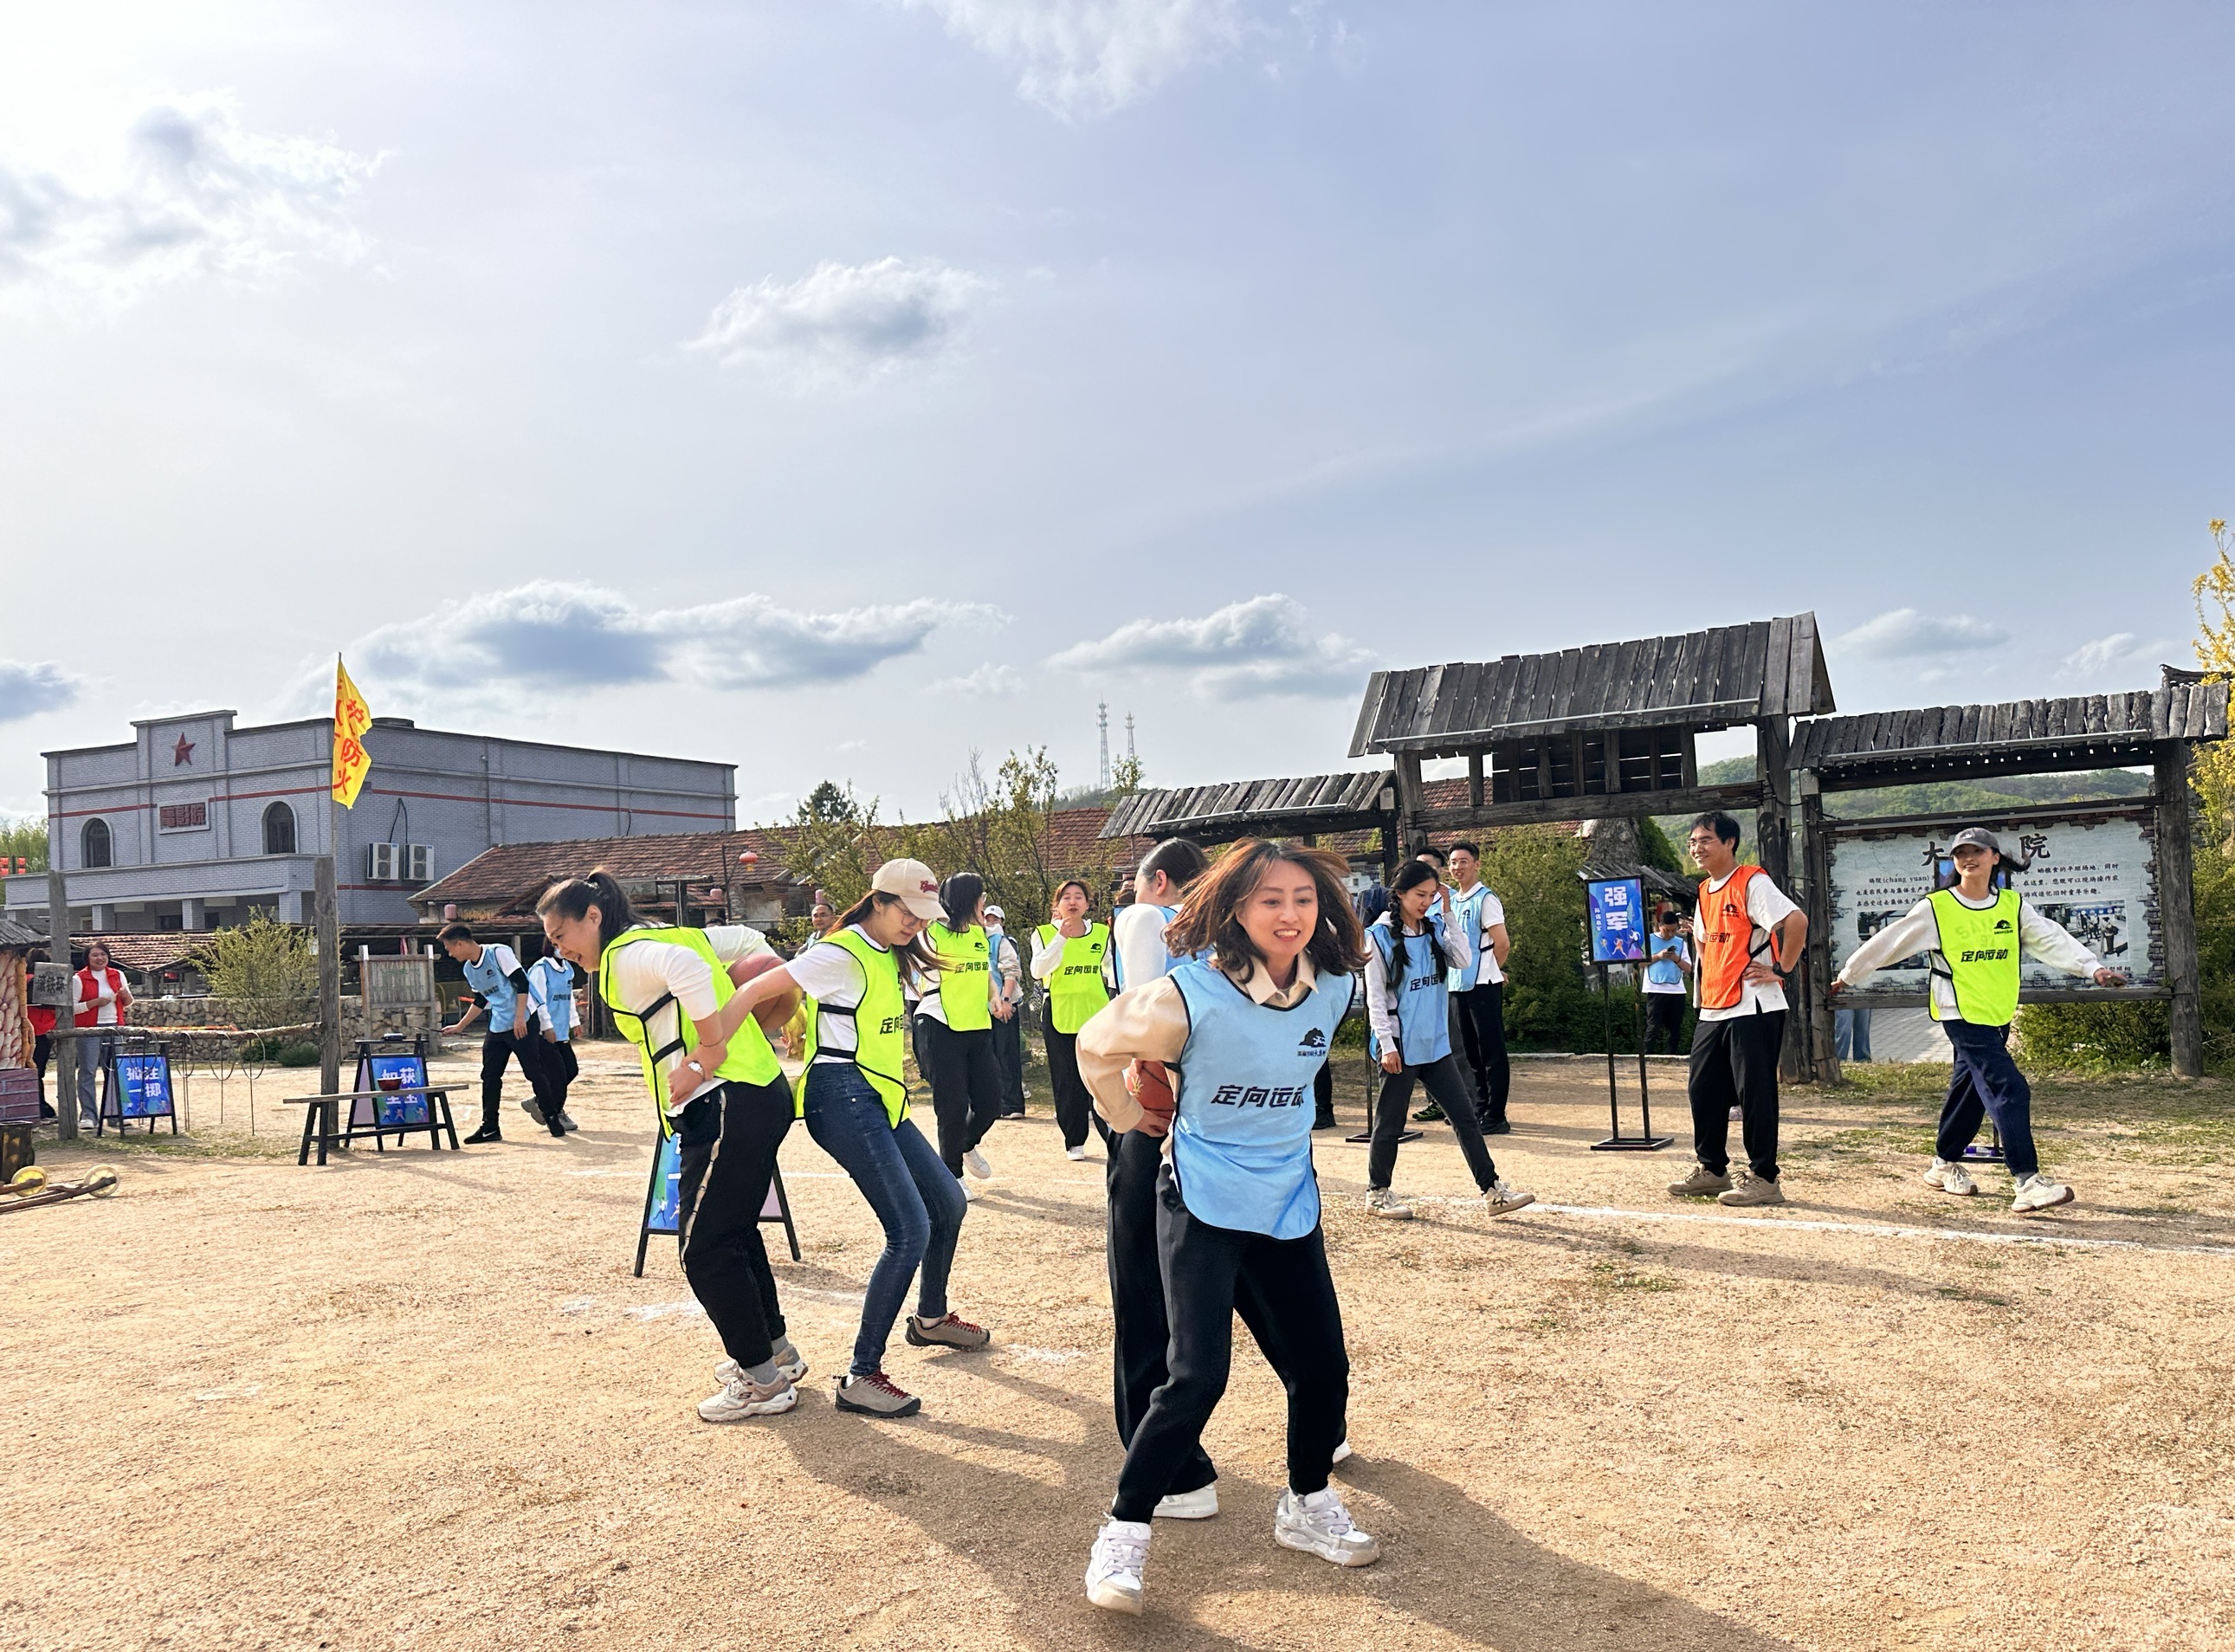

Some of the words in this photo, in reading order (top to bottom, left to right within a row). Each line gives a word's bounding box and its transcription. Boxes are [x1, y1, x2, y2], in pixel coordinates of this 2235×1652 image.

[1604, 886, 1628, 931] 强军
[1960, 948, 2009, 963] 定向运动
[1410, 973, 1439, 992] 定向运
